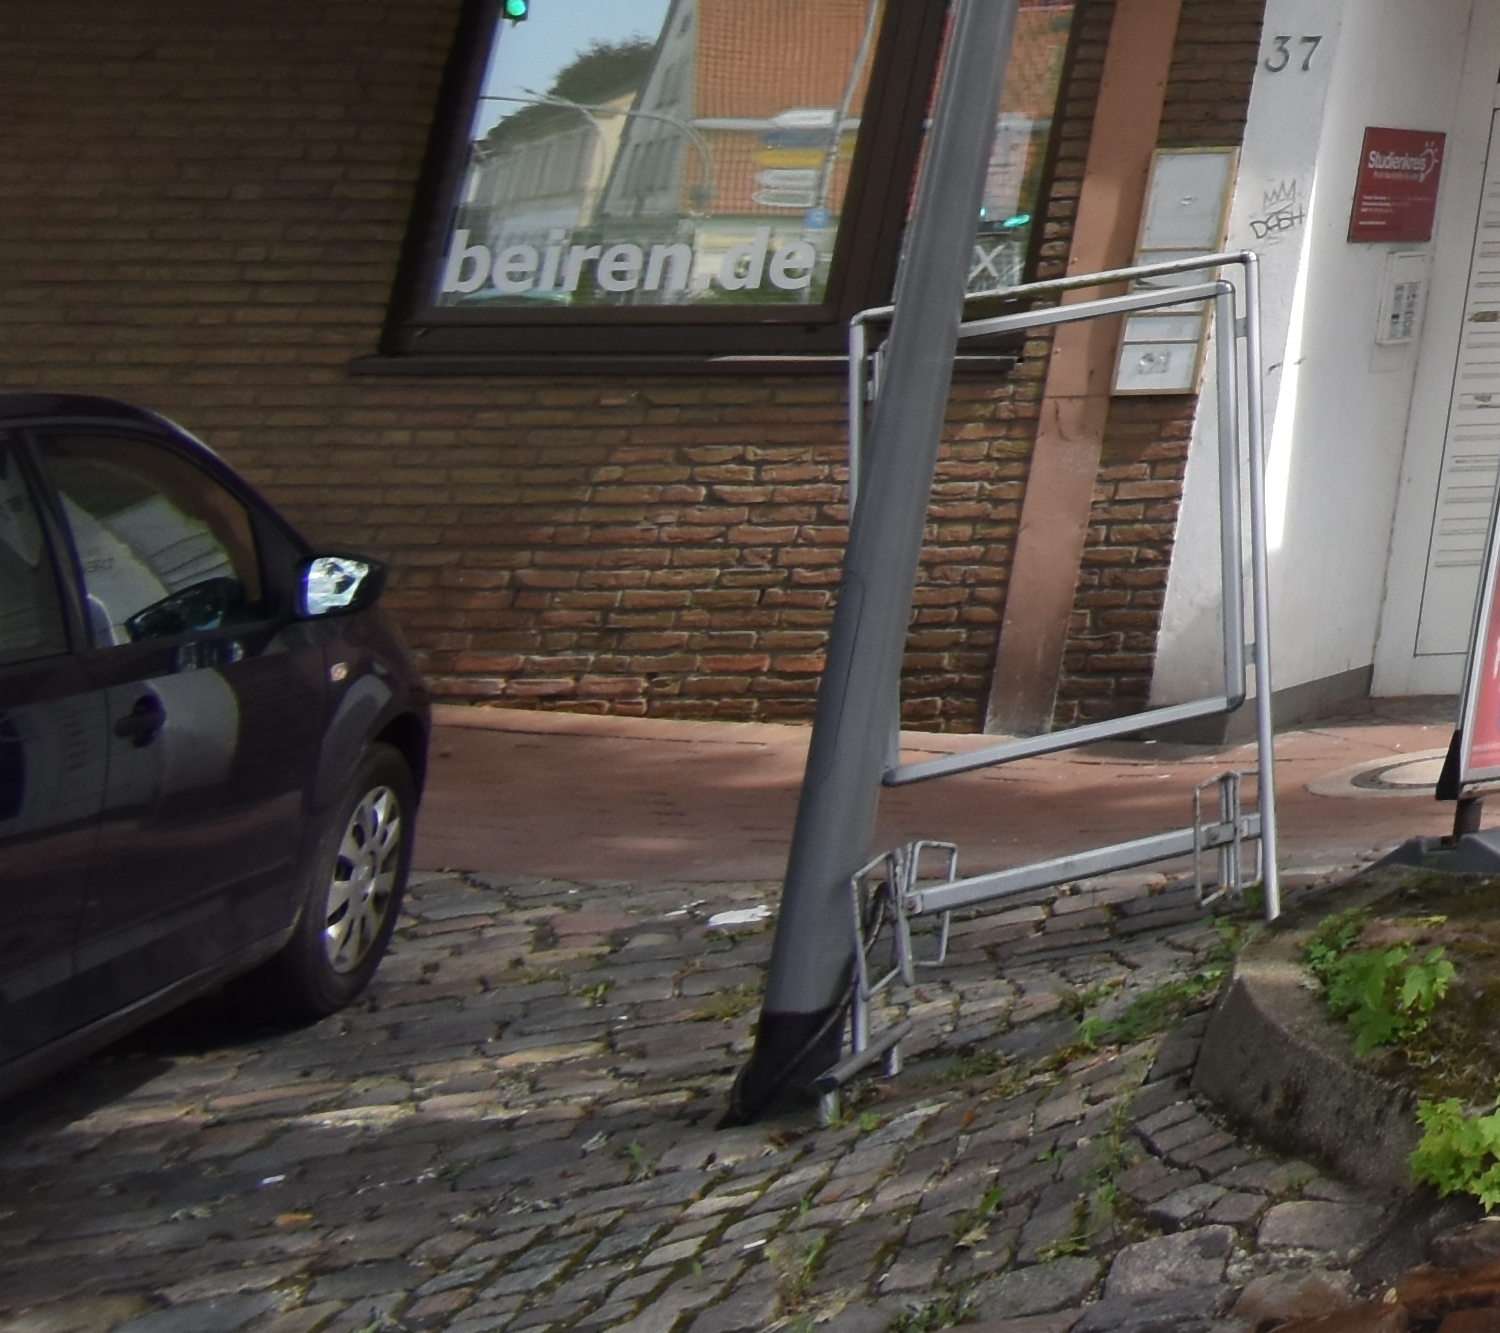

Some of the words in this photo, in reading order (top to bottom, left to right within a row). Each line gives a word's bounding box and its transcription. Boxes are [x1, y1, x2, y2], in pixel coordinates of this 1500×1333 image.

[1264, 35, 1323, 73] 37
[1368, 150, 1427, 171] Studienkreis
[442, 226, 816, 293] beiren.de
